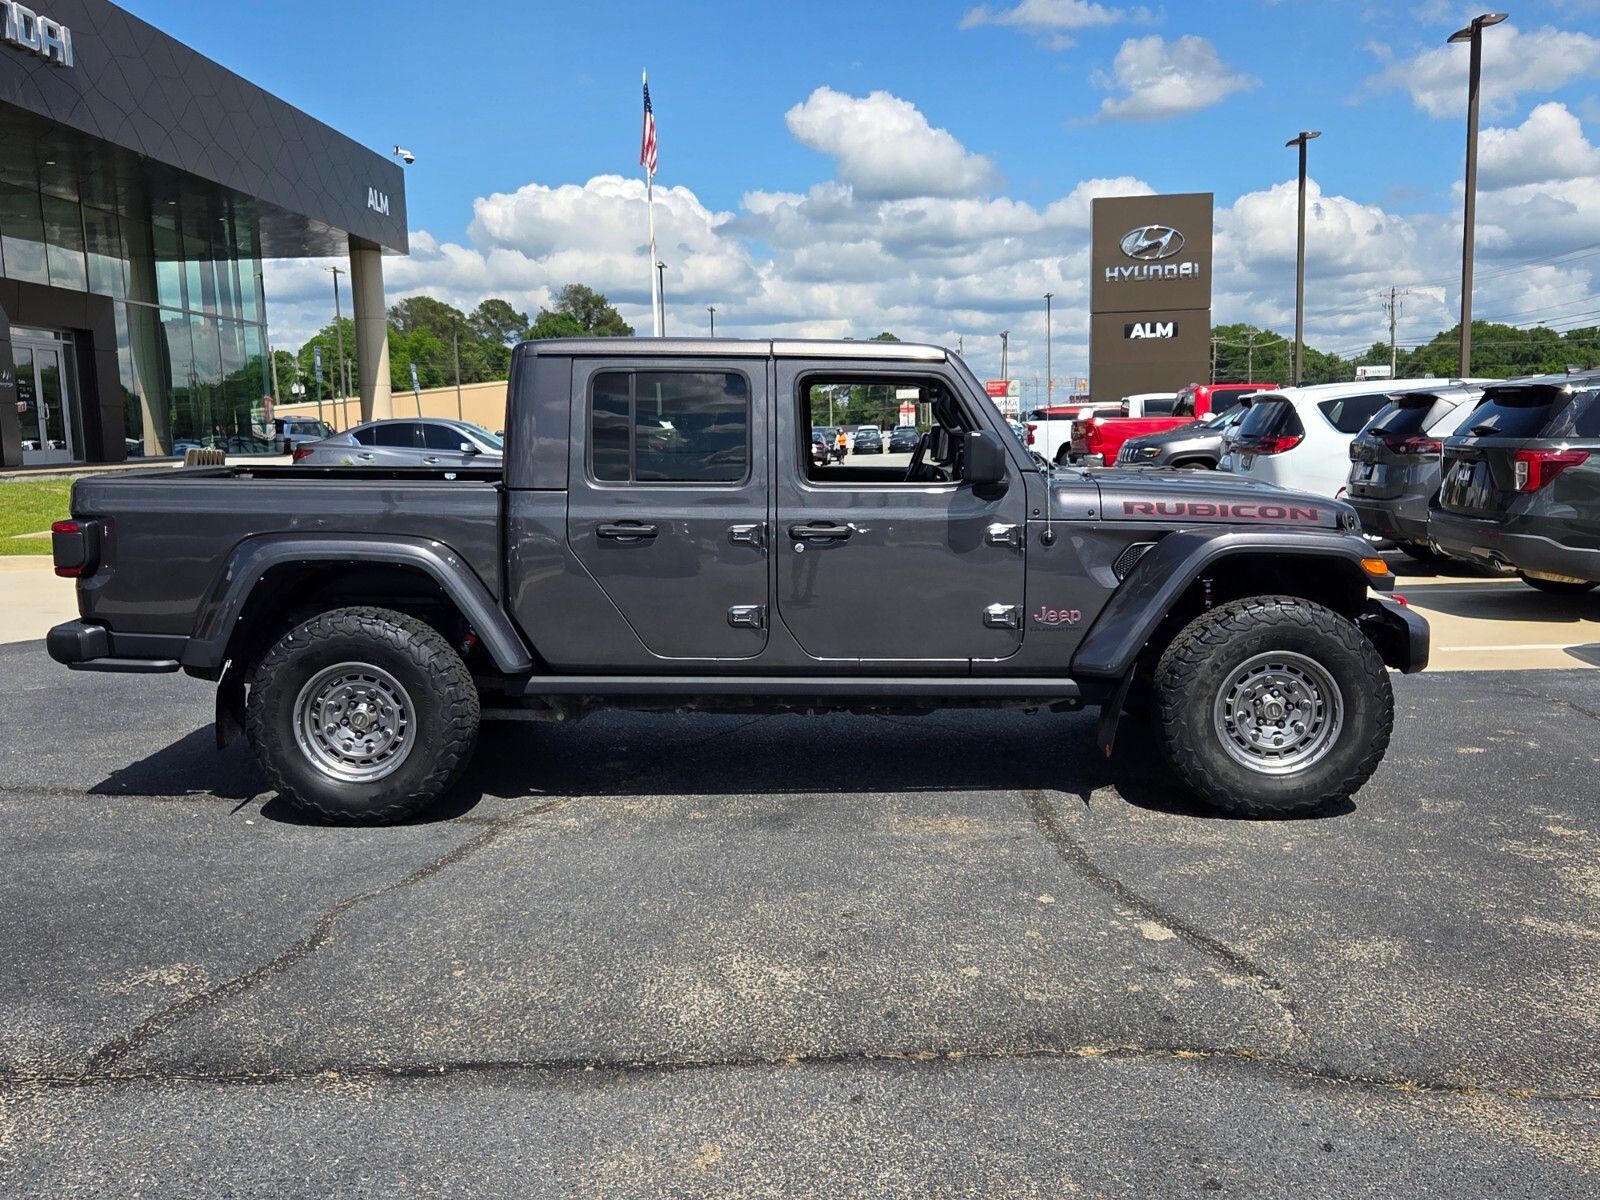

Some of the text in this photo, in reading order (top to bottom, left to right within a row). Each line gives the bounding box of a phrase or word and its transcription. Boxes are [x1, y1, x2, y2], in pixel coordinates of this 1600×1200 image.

[367, 186, 390, 216] ALM
[1105, 262, 1199, 282] HYUNDAI
[1129, 322, 1174, 339] ALM
[1122, 501, 1319, 521] RUBICON
[1033, 606, 1081, 625] Jeep
